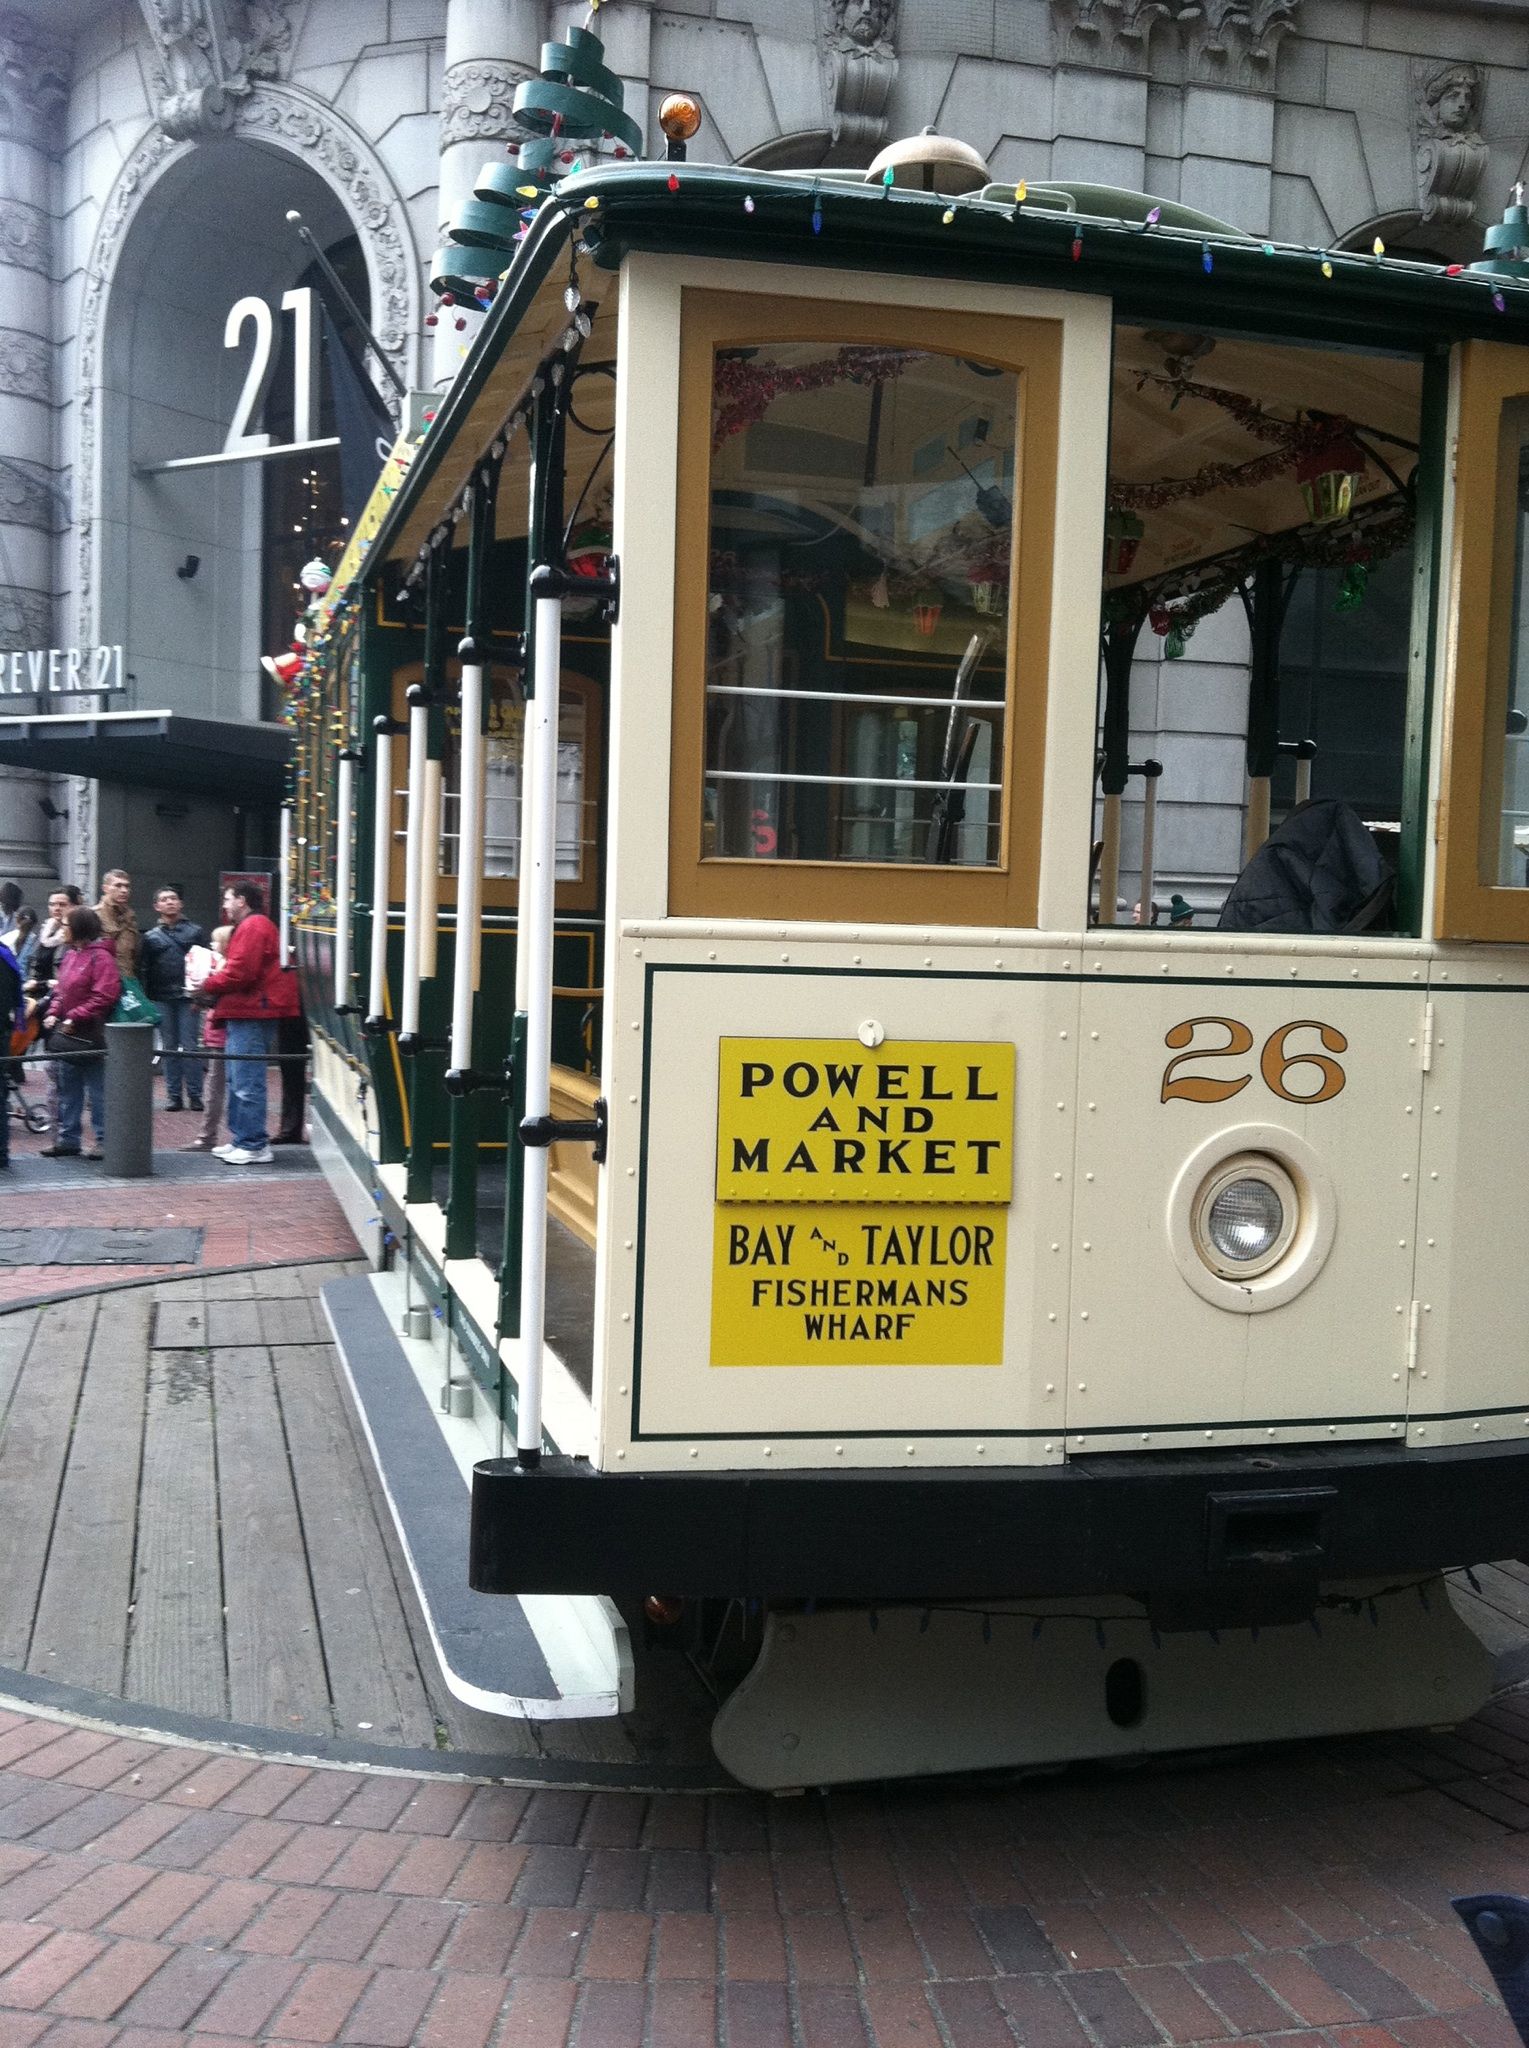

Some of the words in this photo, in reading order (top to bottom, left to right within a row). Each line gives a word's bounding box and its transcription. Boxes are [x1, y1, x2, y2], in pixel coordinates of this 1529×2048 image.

[223, 286, 312, 454] 21
[95, 645, 123, 689] 21
[1160, 1016, 1349, 1105] 26
[740, 1061, 999, 1101] POWELL
[807, 1105, 935, 1134] AND
[731, 1137, 1002, 1175] MARKET
[728, 1224, 796, 1266] BAY
[809, 1226, 850, 1266] AND
[861, 1224, 995, 1266] TAYLOR
[751, 1279, 969, 1307] FISHERMANS
[804, 1313, 917, 1341] WHARF
